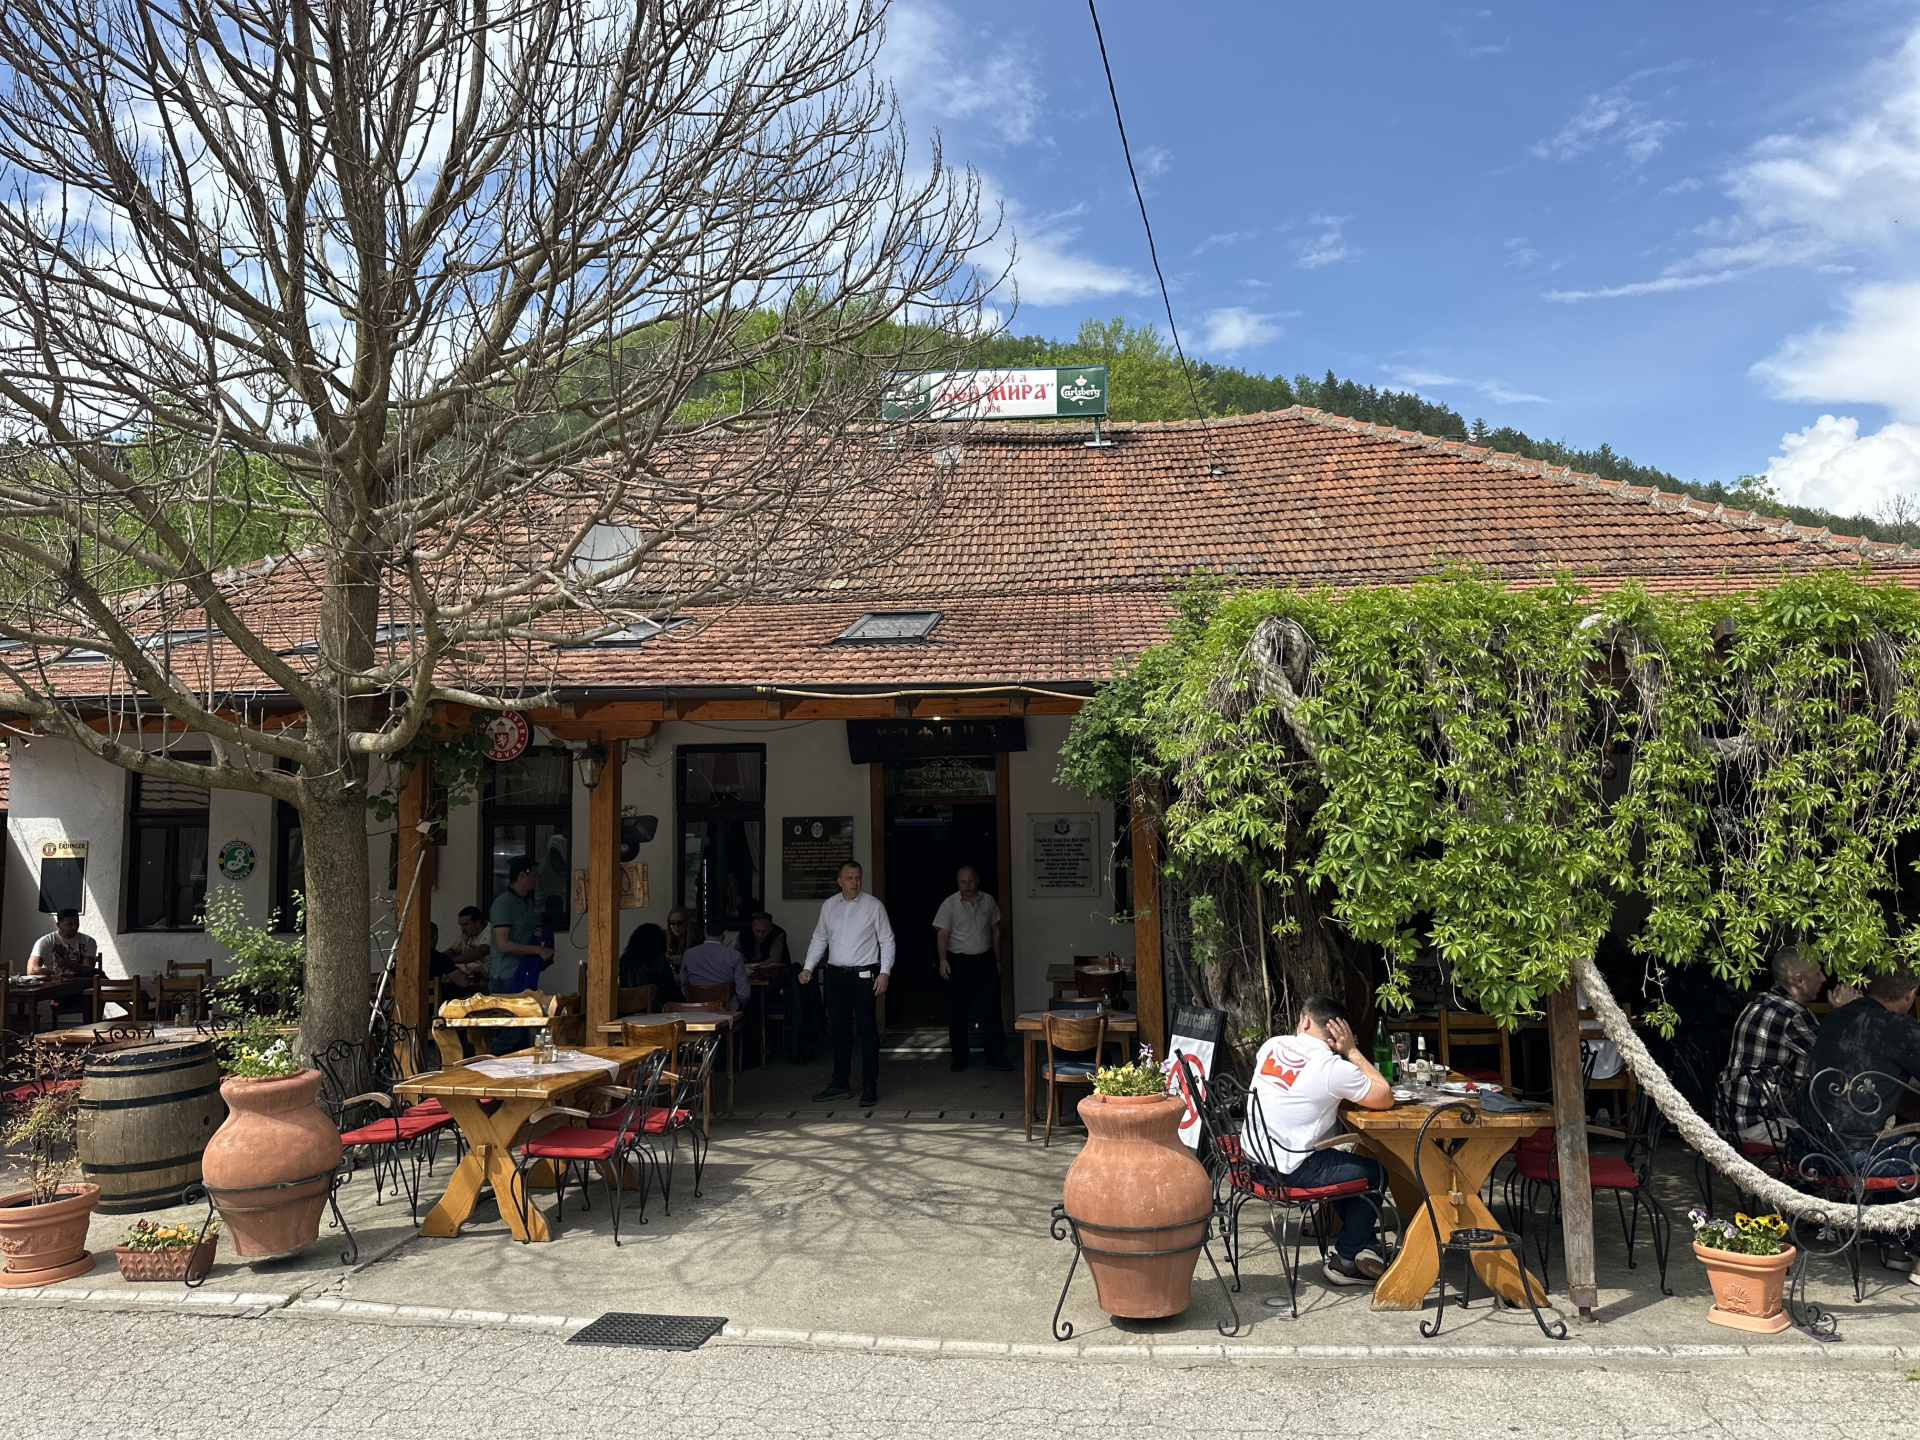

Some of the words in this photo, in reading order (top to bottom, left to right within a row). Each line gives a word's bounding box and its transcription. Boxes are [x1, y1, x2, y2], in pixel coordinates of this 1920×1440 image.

[1060, 384, 1101, 402] Carlsberg
[487, 742, 523, 758] UDVAR
[58, 841, 86, 850] ERDINGER
[221, 841, 252, 854] BROOKLYN
[222, 868, 251, 880] BREWERY
